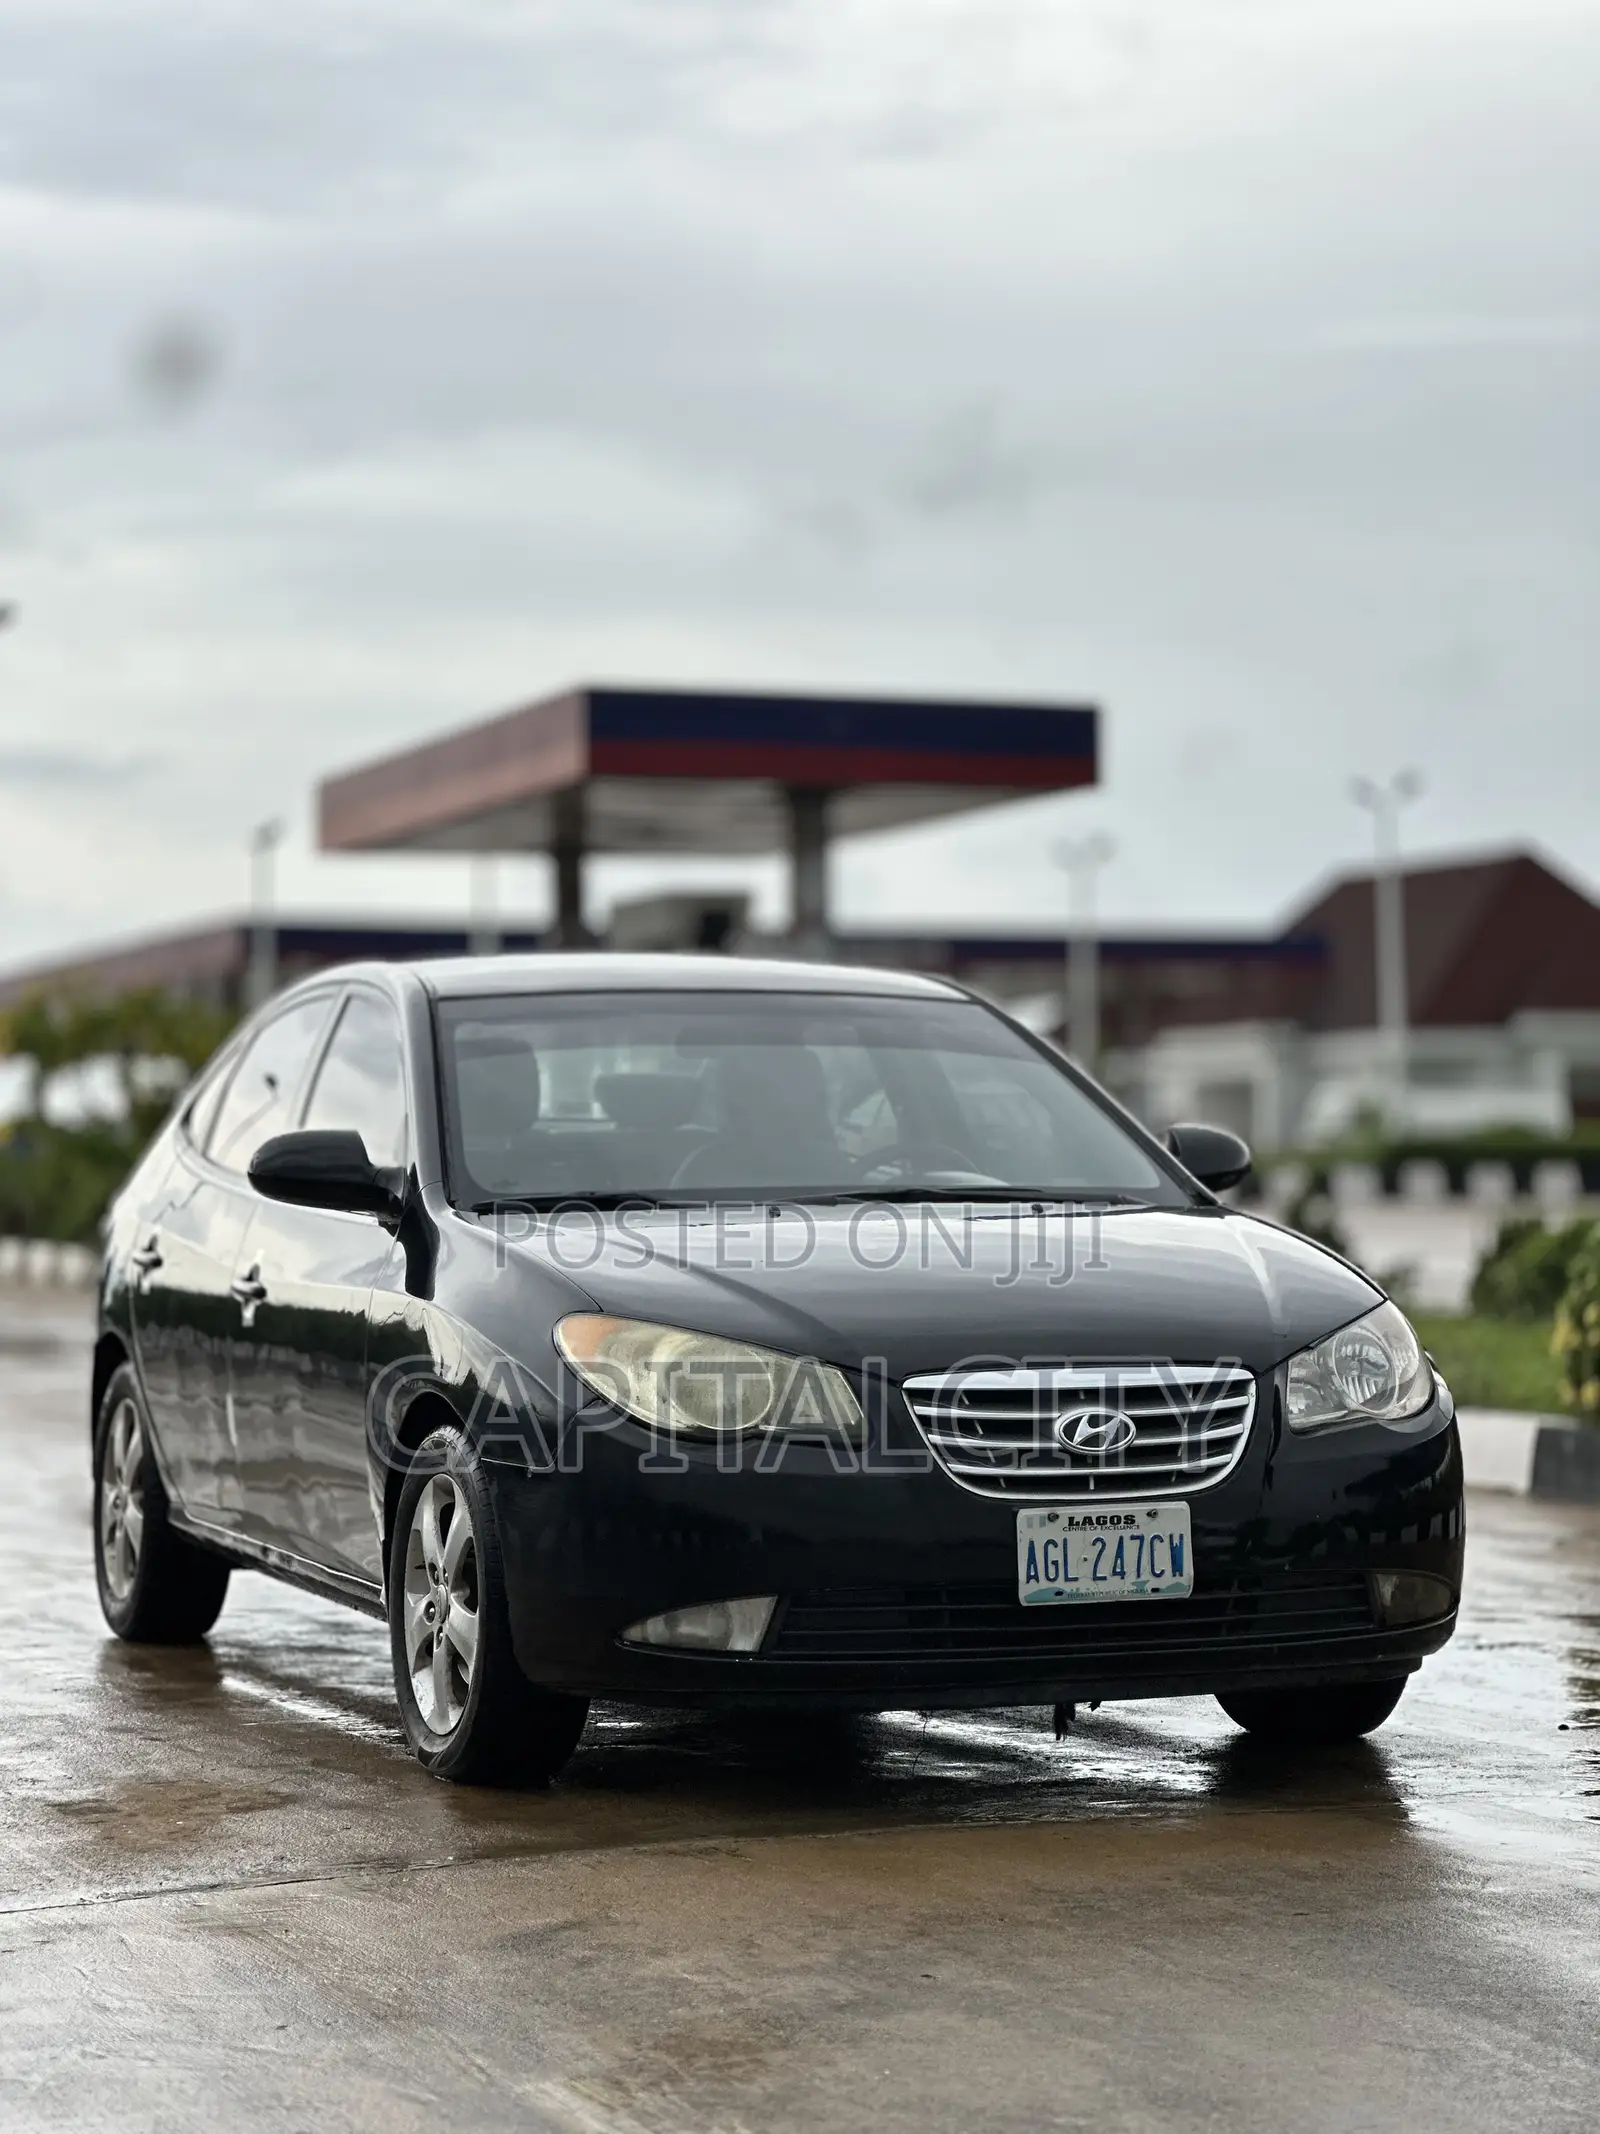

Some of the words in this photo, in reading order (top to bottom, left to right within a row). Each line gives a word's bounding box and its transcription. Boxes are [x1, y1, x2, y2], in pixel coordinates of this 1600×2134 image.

[1068, 1514, 1136, 1527] LAGOS
[1026, 1537, 1079, 1584] AGL
[1092, 1533, 1184, 1581] 247CW
